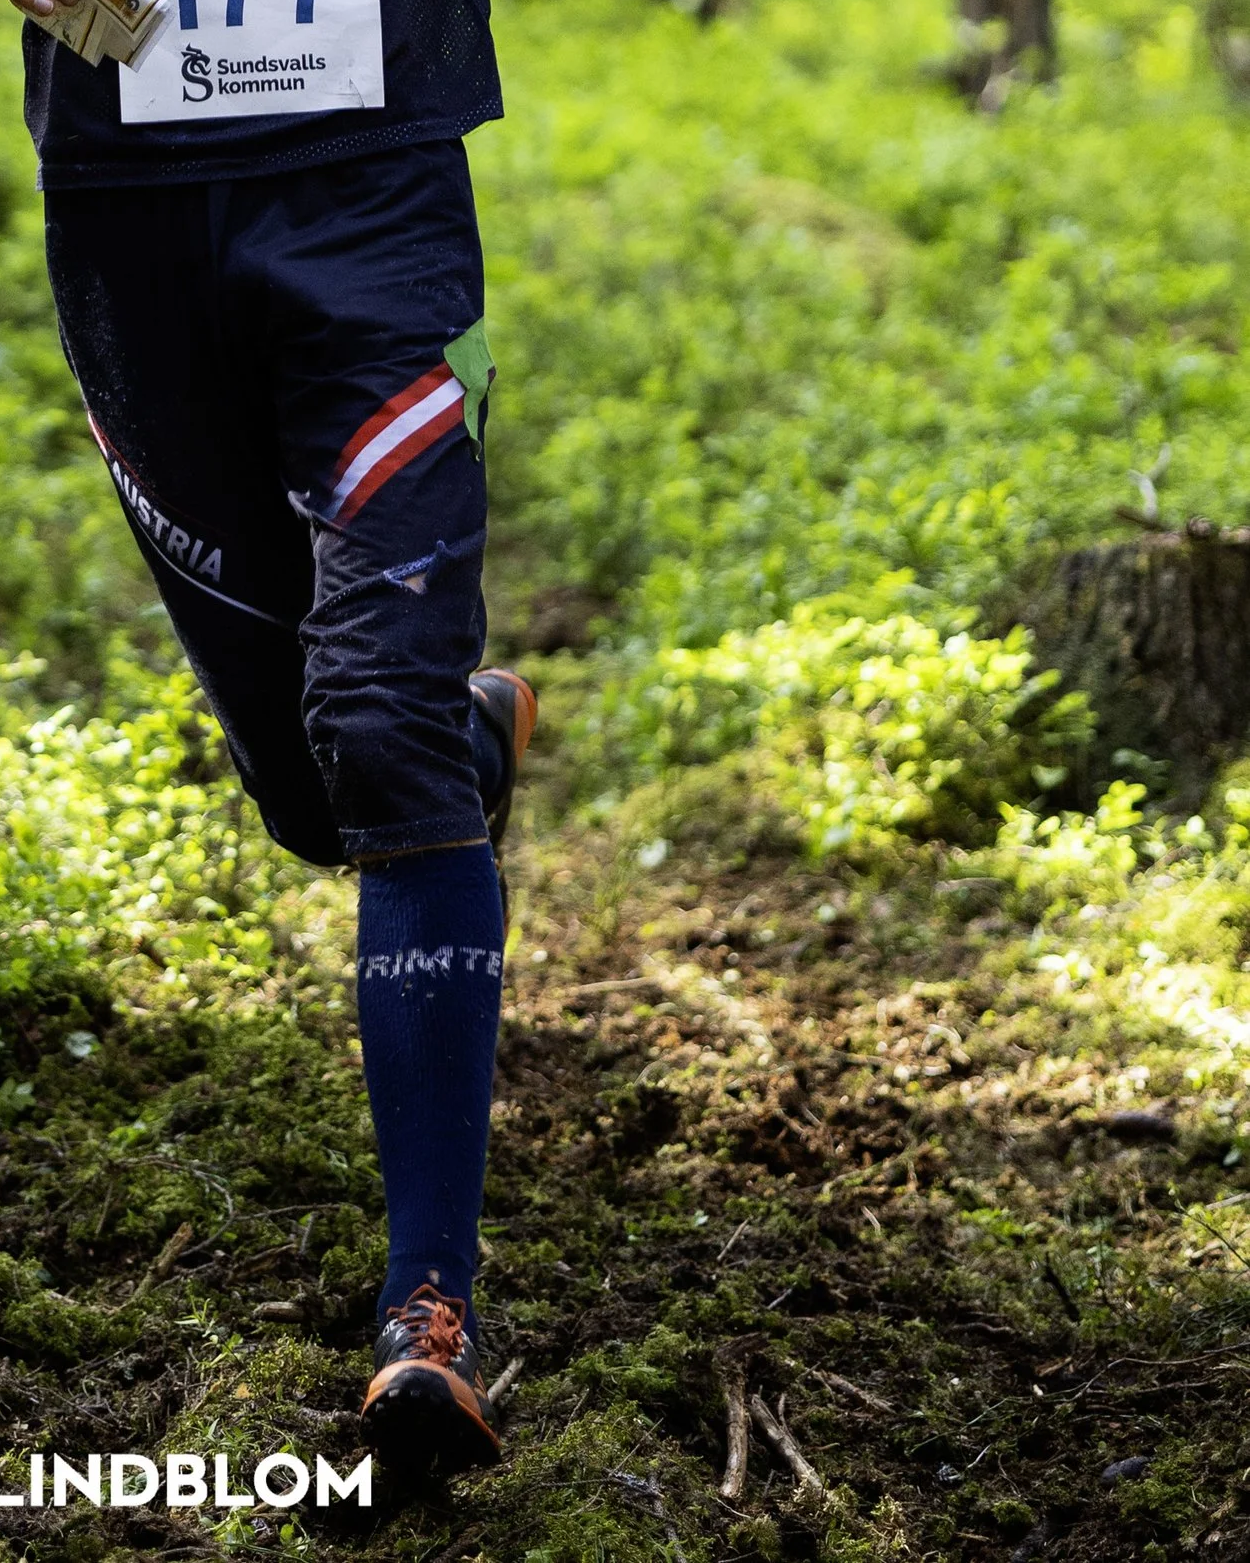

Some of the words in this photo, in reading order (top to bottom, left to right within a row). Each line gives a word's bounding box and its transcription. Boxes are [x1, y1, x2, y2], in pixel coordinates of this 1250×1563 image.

[217, 53, 327, 76] Sundsvalls
[218, 76, 306, 96] kommun
[112, 460, 222, 583] AUSTRIA
